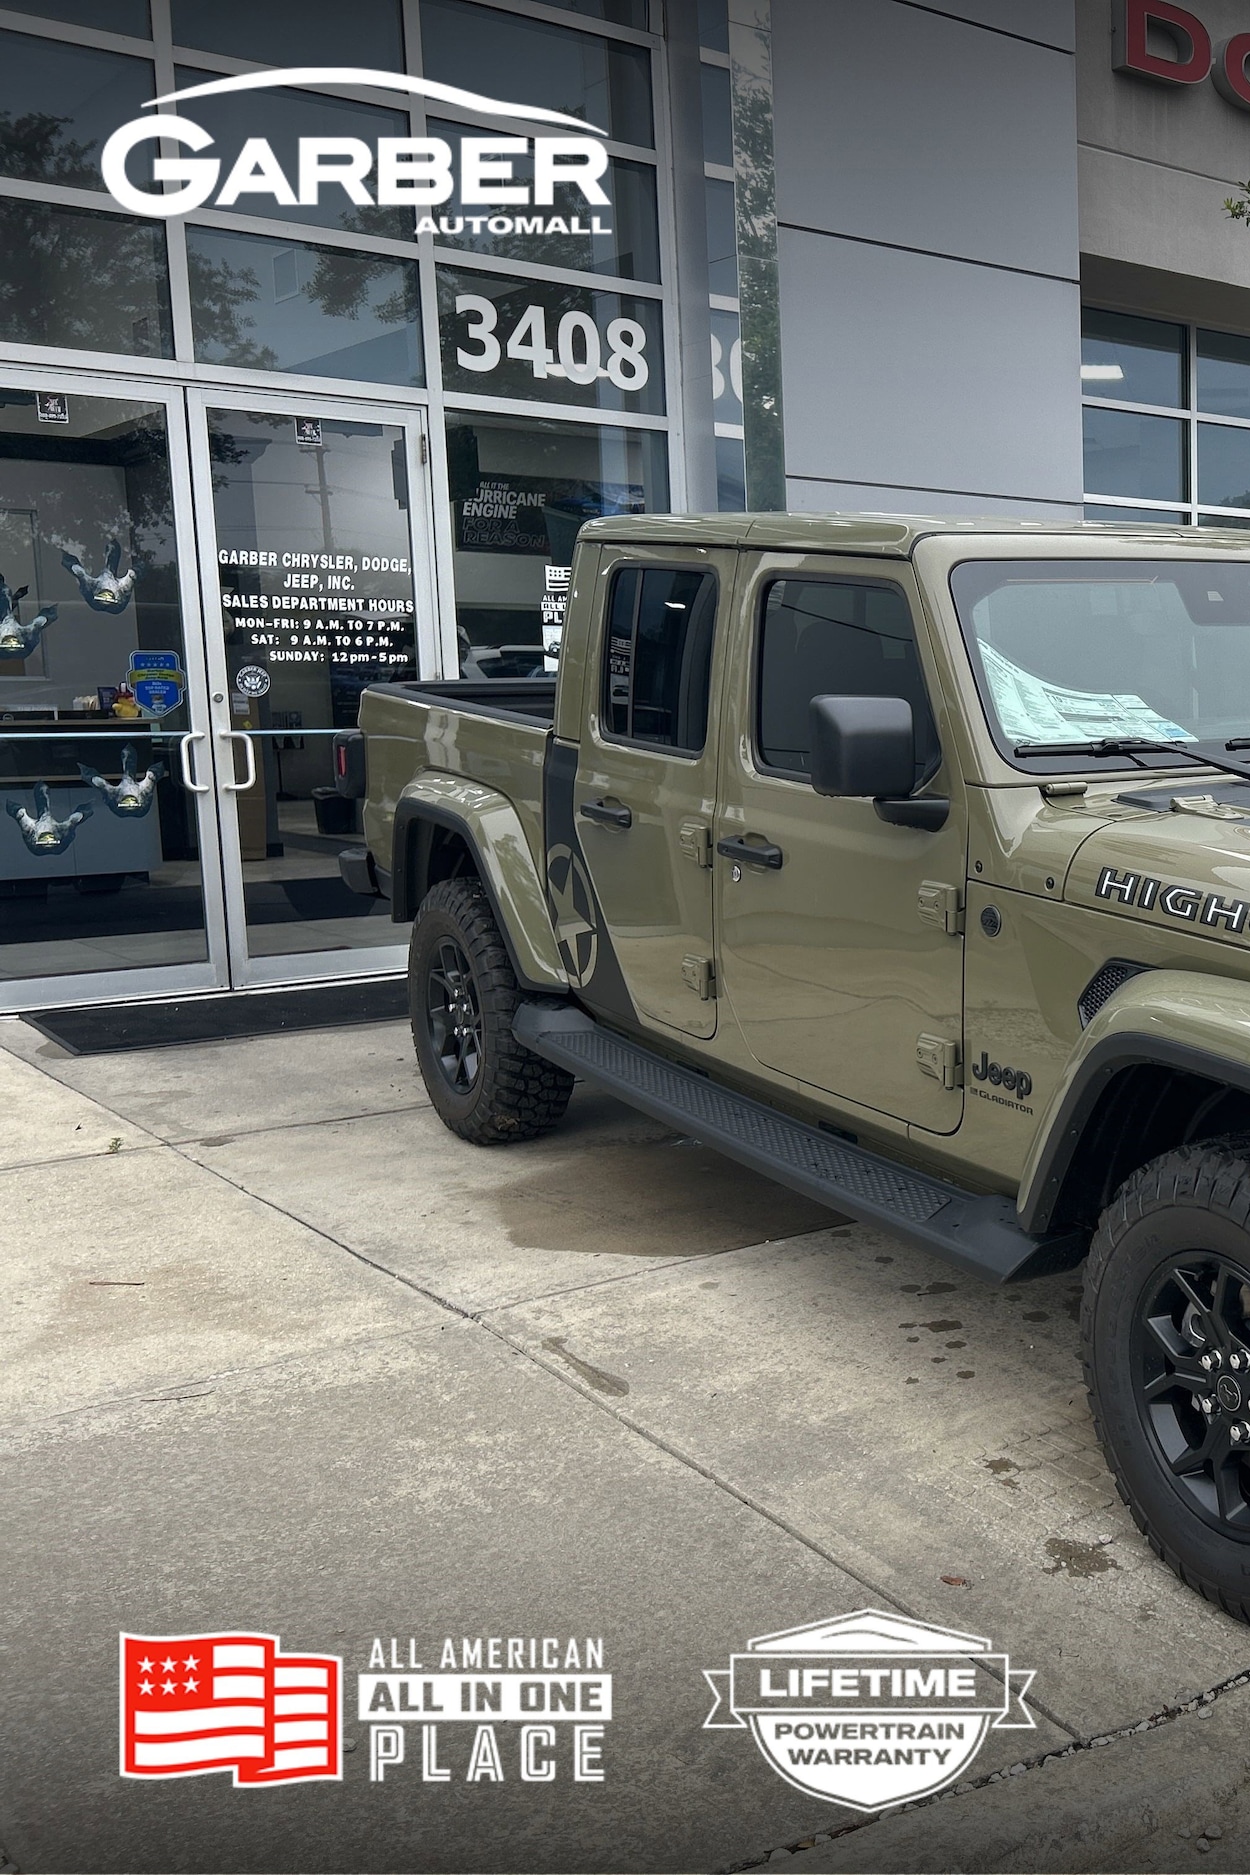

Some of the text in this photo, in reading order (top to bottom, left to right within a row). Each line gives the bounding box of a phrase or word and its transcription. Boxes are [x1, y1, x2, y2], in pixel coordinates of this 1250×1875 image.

[455, 294, 649, 391] 3408
[462, 502, 518, 519] ENGINE
[463, 530, 545, 548] REASON
[218, 549, 412, 576] GARBER CHRYSLER, DODGE,
[283, 574, 355, 592] JEEP, INC.
[222, 594, 415, 614] SALES DEPARTMENT HOURS
[235, 617, 405, 632] MON-FRI: 9 A.M. TO 7 P.M.
[251, 634, 393, 648] SAT: 9 A.M. TO 6 P.M.
[269, 651, 325, 662] SUNDAY:
[1095, 866, 1250, 933] HIGH
[972, 1051, 1032, 1100] Jeep
[979, 1089, 1034, 1116] GLADIATOR
